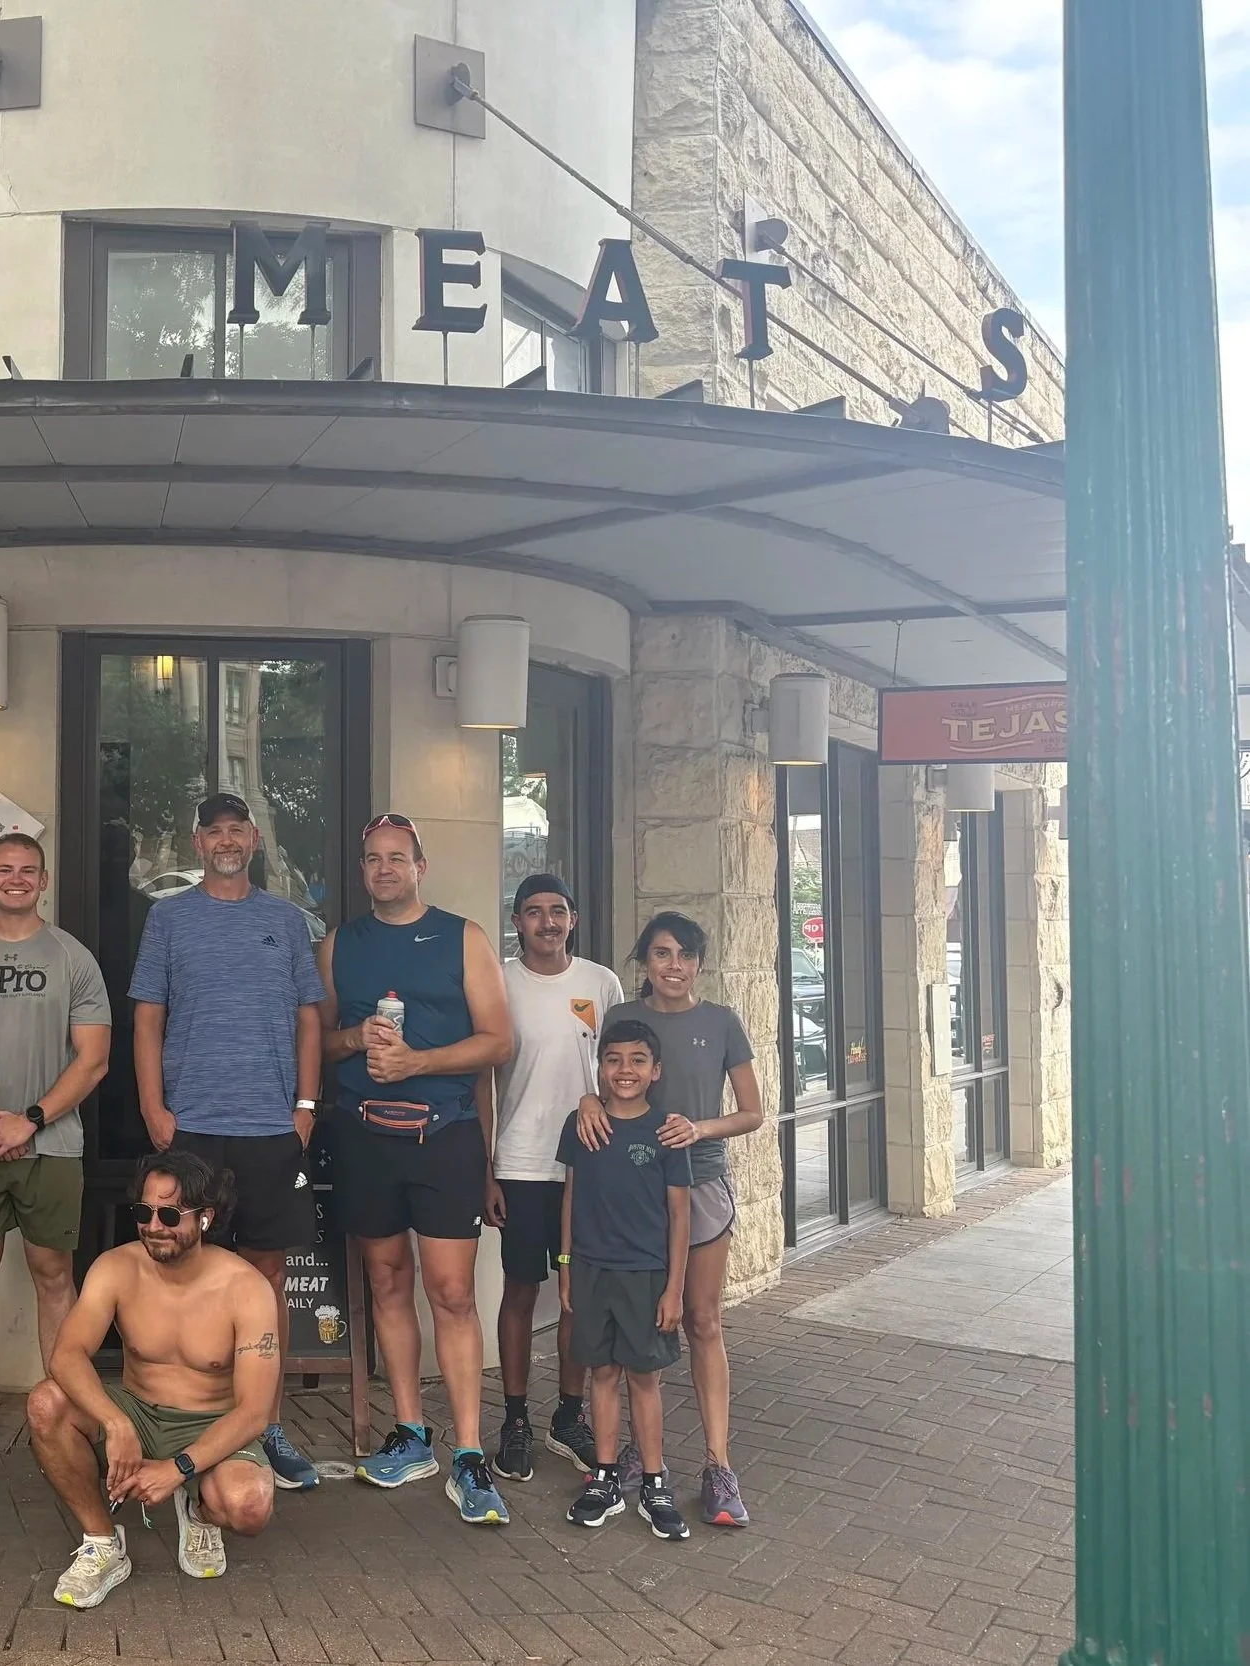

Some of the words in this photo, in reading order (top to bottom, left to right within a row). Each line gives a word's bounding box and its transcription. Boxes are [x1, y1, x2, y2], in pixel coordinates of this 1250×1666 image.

[226, 220, 1025, 402] MEATS
[285, 1252, 329, 1267] and...
[284, 1276, 329, 1292] MEAT
[287, 1298, 314, 1309] AILY
